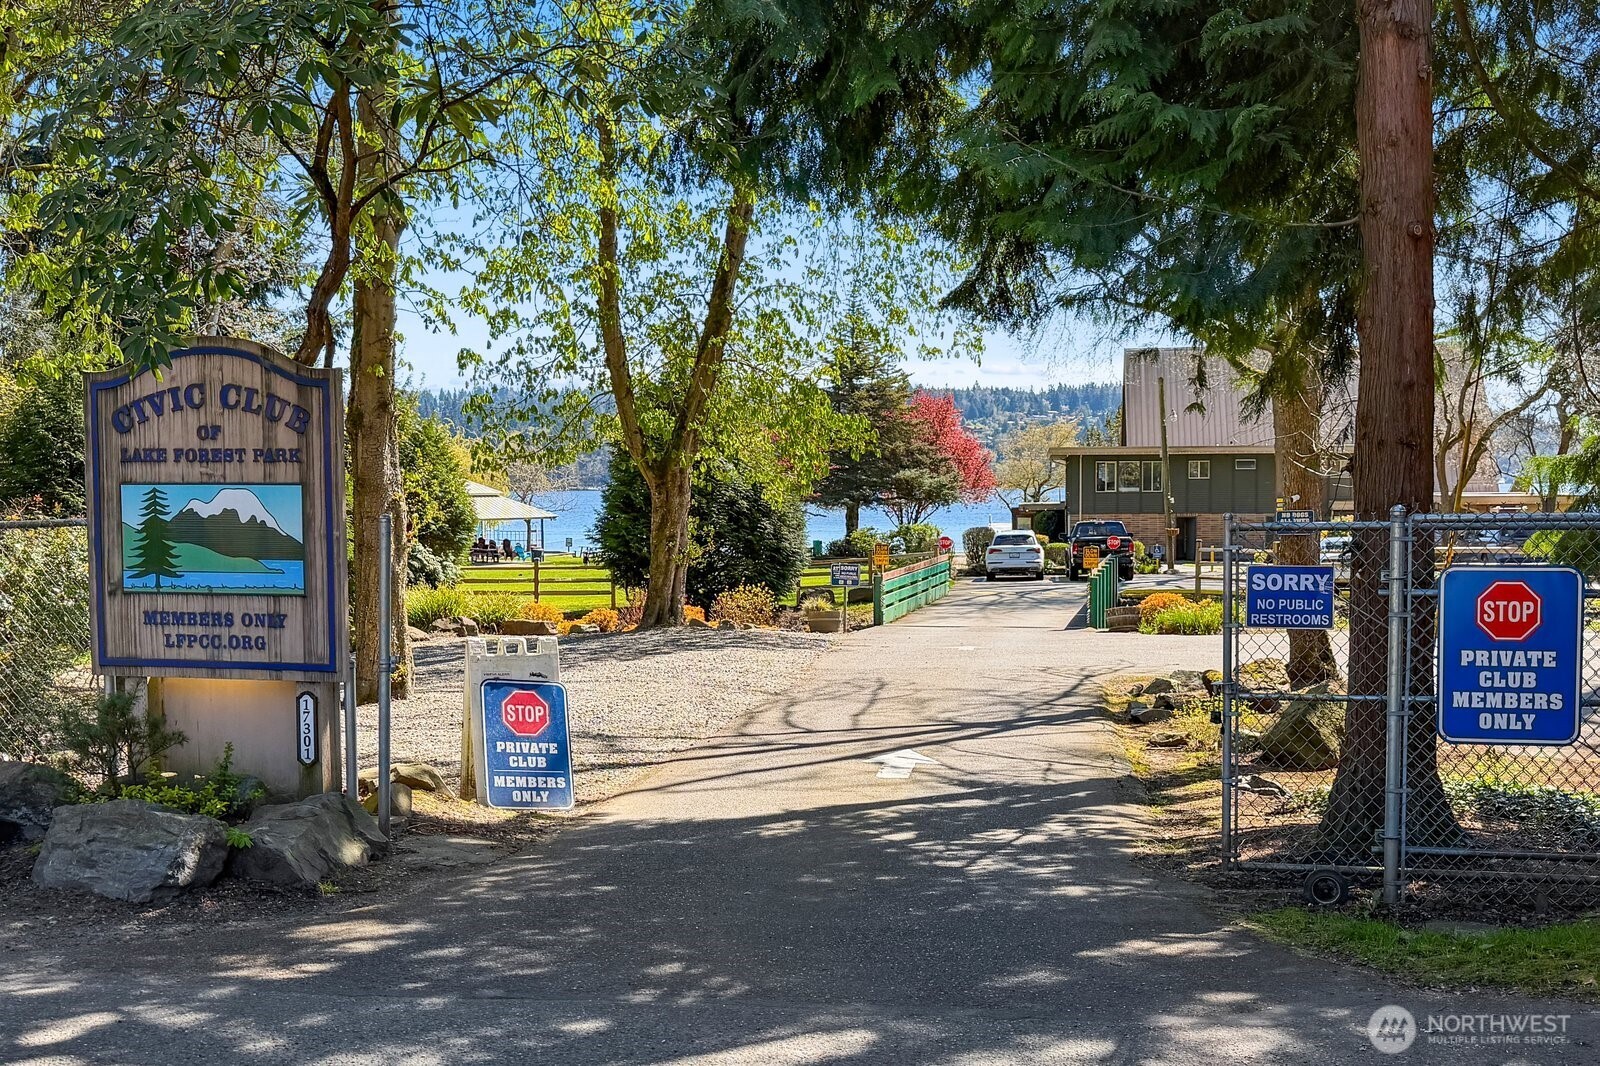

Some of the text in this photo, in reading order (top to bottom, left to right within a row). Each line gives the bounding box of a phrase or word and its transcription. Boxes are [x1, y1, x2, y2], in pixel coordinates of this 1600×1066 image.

[111, 383, 311, 435] CIVIC CLUB
[196, 425, 221, 441] OF
[120, 448, 303, 463] LAKE FOREST PARK
[1251, 573, 1330, 593] SORRY
[1257, 599, 1324, 610] NO PUBLIC
[1483, 600, 1535, 622] STOP
[143, 611, 288, 628] MEMBERS ONLY
[1251, 614, 1330, 625] RESTROOMS
[164, 633, 267, 650] LFPCC.ORG
[1461, 650, 1557, 667] PRIVATE
[1479, 671, 1537, 688] CLUB
[1452, 691, 1563, 710] MEMBERS
[506, 704, 545, 723] STOP
[1479, 713, 1536, 730] ONLY
[302, 699, 312, 760] 17301
[496, 741, 558, 754] PRIVATE
[509, 756, 547, 768] CLUB
[493, 775, 566, 788] MEMBERS
[512, 790, 549, 803] ONLY
